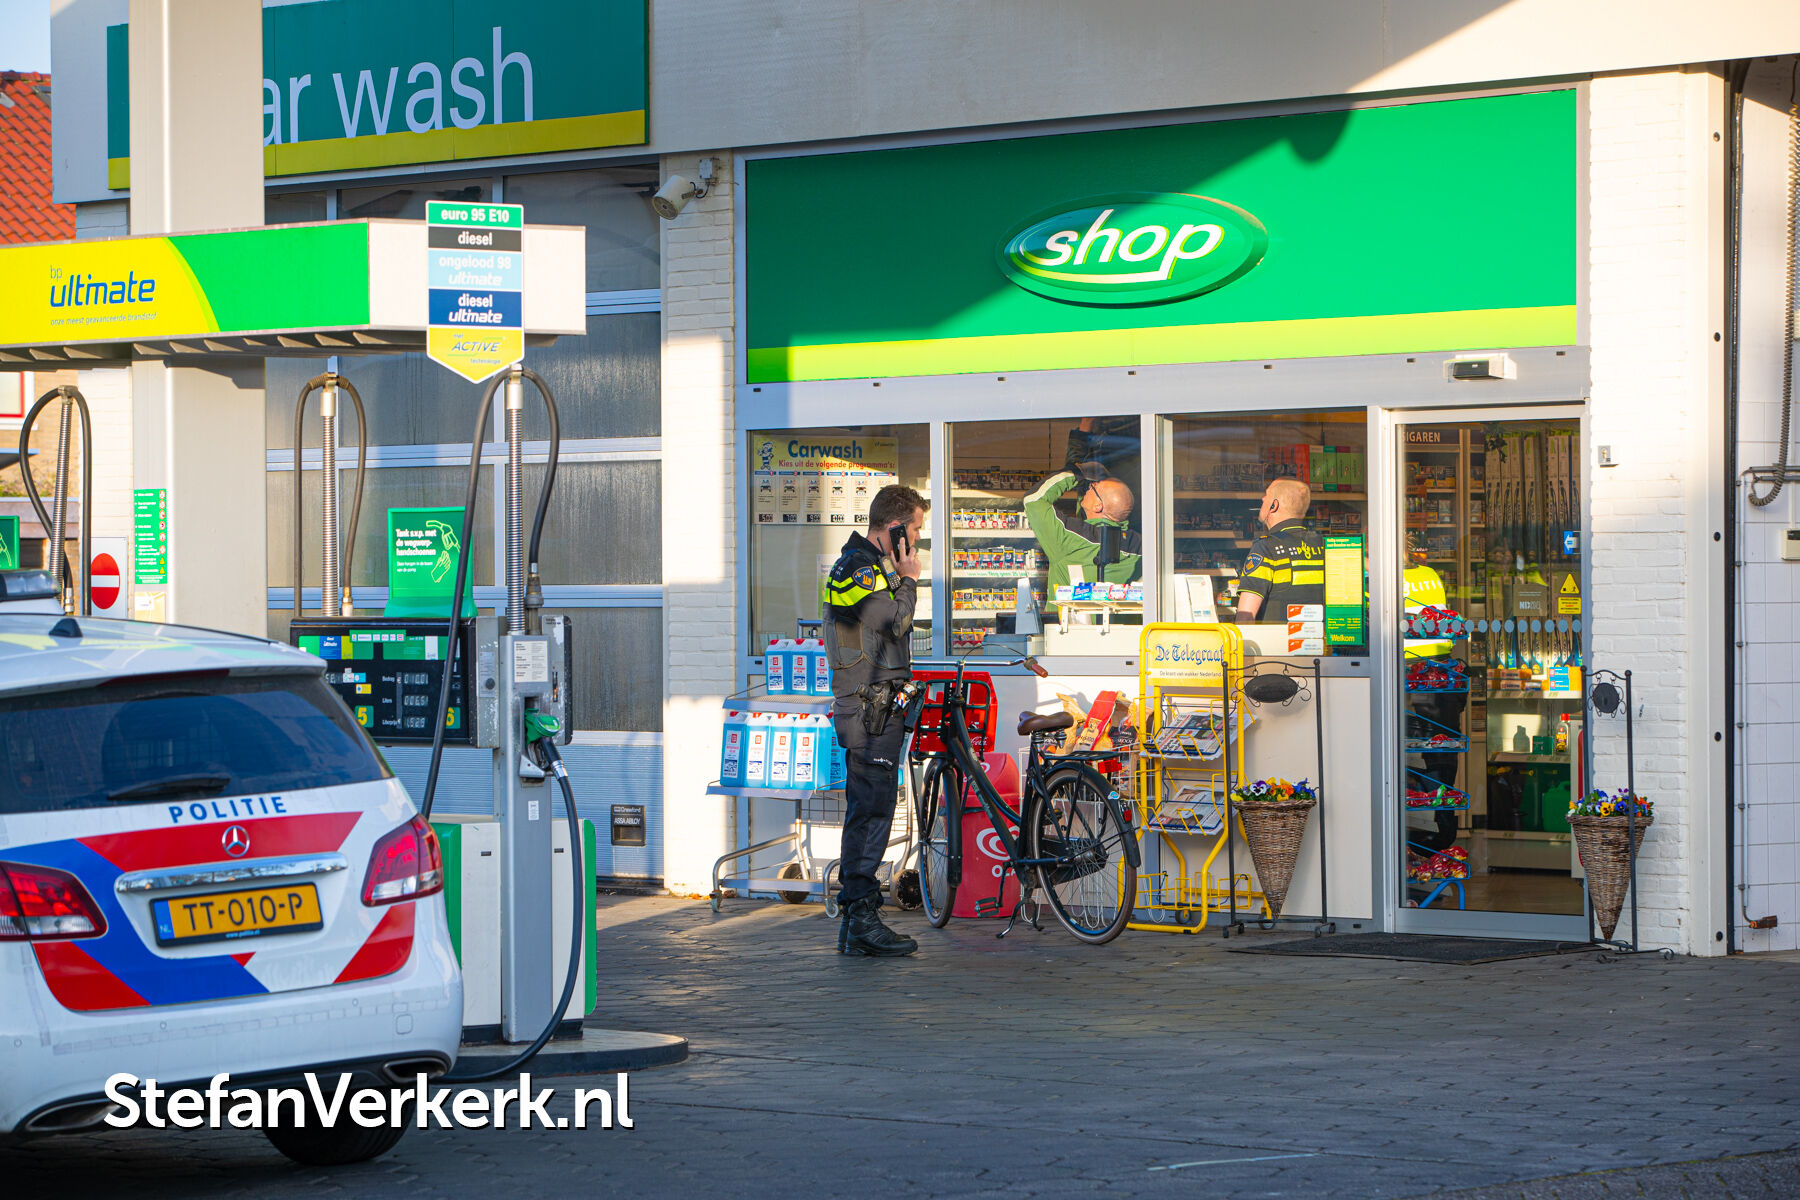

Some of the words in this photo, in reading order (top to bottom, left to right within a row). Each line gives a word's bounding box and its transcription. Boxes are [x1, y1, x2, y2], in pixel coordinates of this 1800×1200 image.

[263, 73, 312, 148] ar
[332, 26, 534, 139] wash
[440, 208, 468, 221] euro
[470, 208, 486, 222] 95
[488, 208, 510, 223] E10
[457, 230, 493, 246] diesel
[1044, 208, 1226, 281] shop
[438, 255, 494, 271] ongelood
[497, 256, 512, 270] 98
[50, 264, 63, 282] bp
[447, 272, 503, 287] ultimate
[50, 270, 156, 308] ultimate
[457, 293, 493, 307] diesel
[50, 318, 65, 326] onze
[65, 317, 85, 325] meest
[85, 314, 126, 326] geavanceerde
[127, 311, 157, 322] brandstof
[448, 308, 503, 324] ultimate
[451, 341, 501, 352] ACTIVE
[787, 439, 863, 459] Carwash
[778, 459, 793, 468] Kies
[794, 459, 804, 468] uit
[805, 459, 814, 468] de
[815, 459, 847, 470] volgende
[395, 528, 410, 538] Tank
[424, 529, 437, 537] met
[395, 538, 404, 547] de
[1296, 541, 1324, 560] POLI
[395, 547, 437, 556] handschoenen
[1403, 579, 1443, 597] OLITI
[1154, 644, 1170, 662] De
[357, 707, 368, 726] 5
[445, 707, 455, 727] 6
[168, 796, 287, 824] POLITIE
[626, 817, 641, 825] ABLOY
[182, 892, 303, 931] TT-010-P
[159, 925, 171, 934] NL
